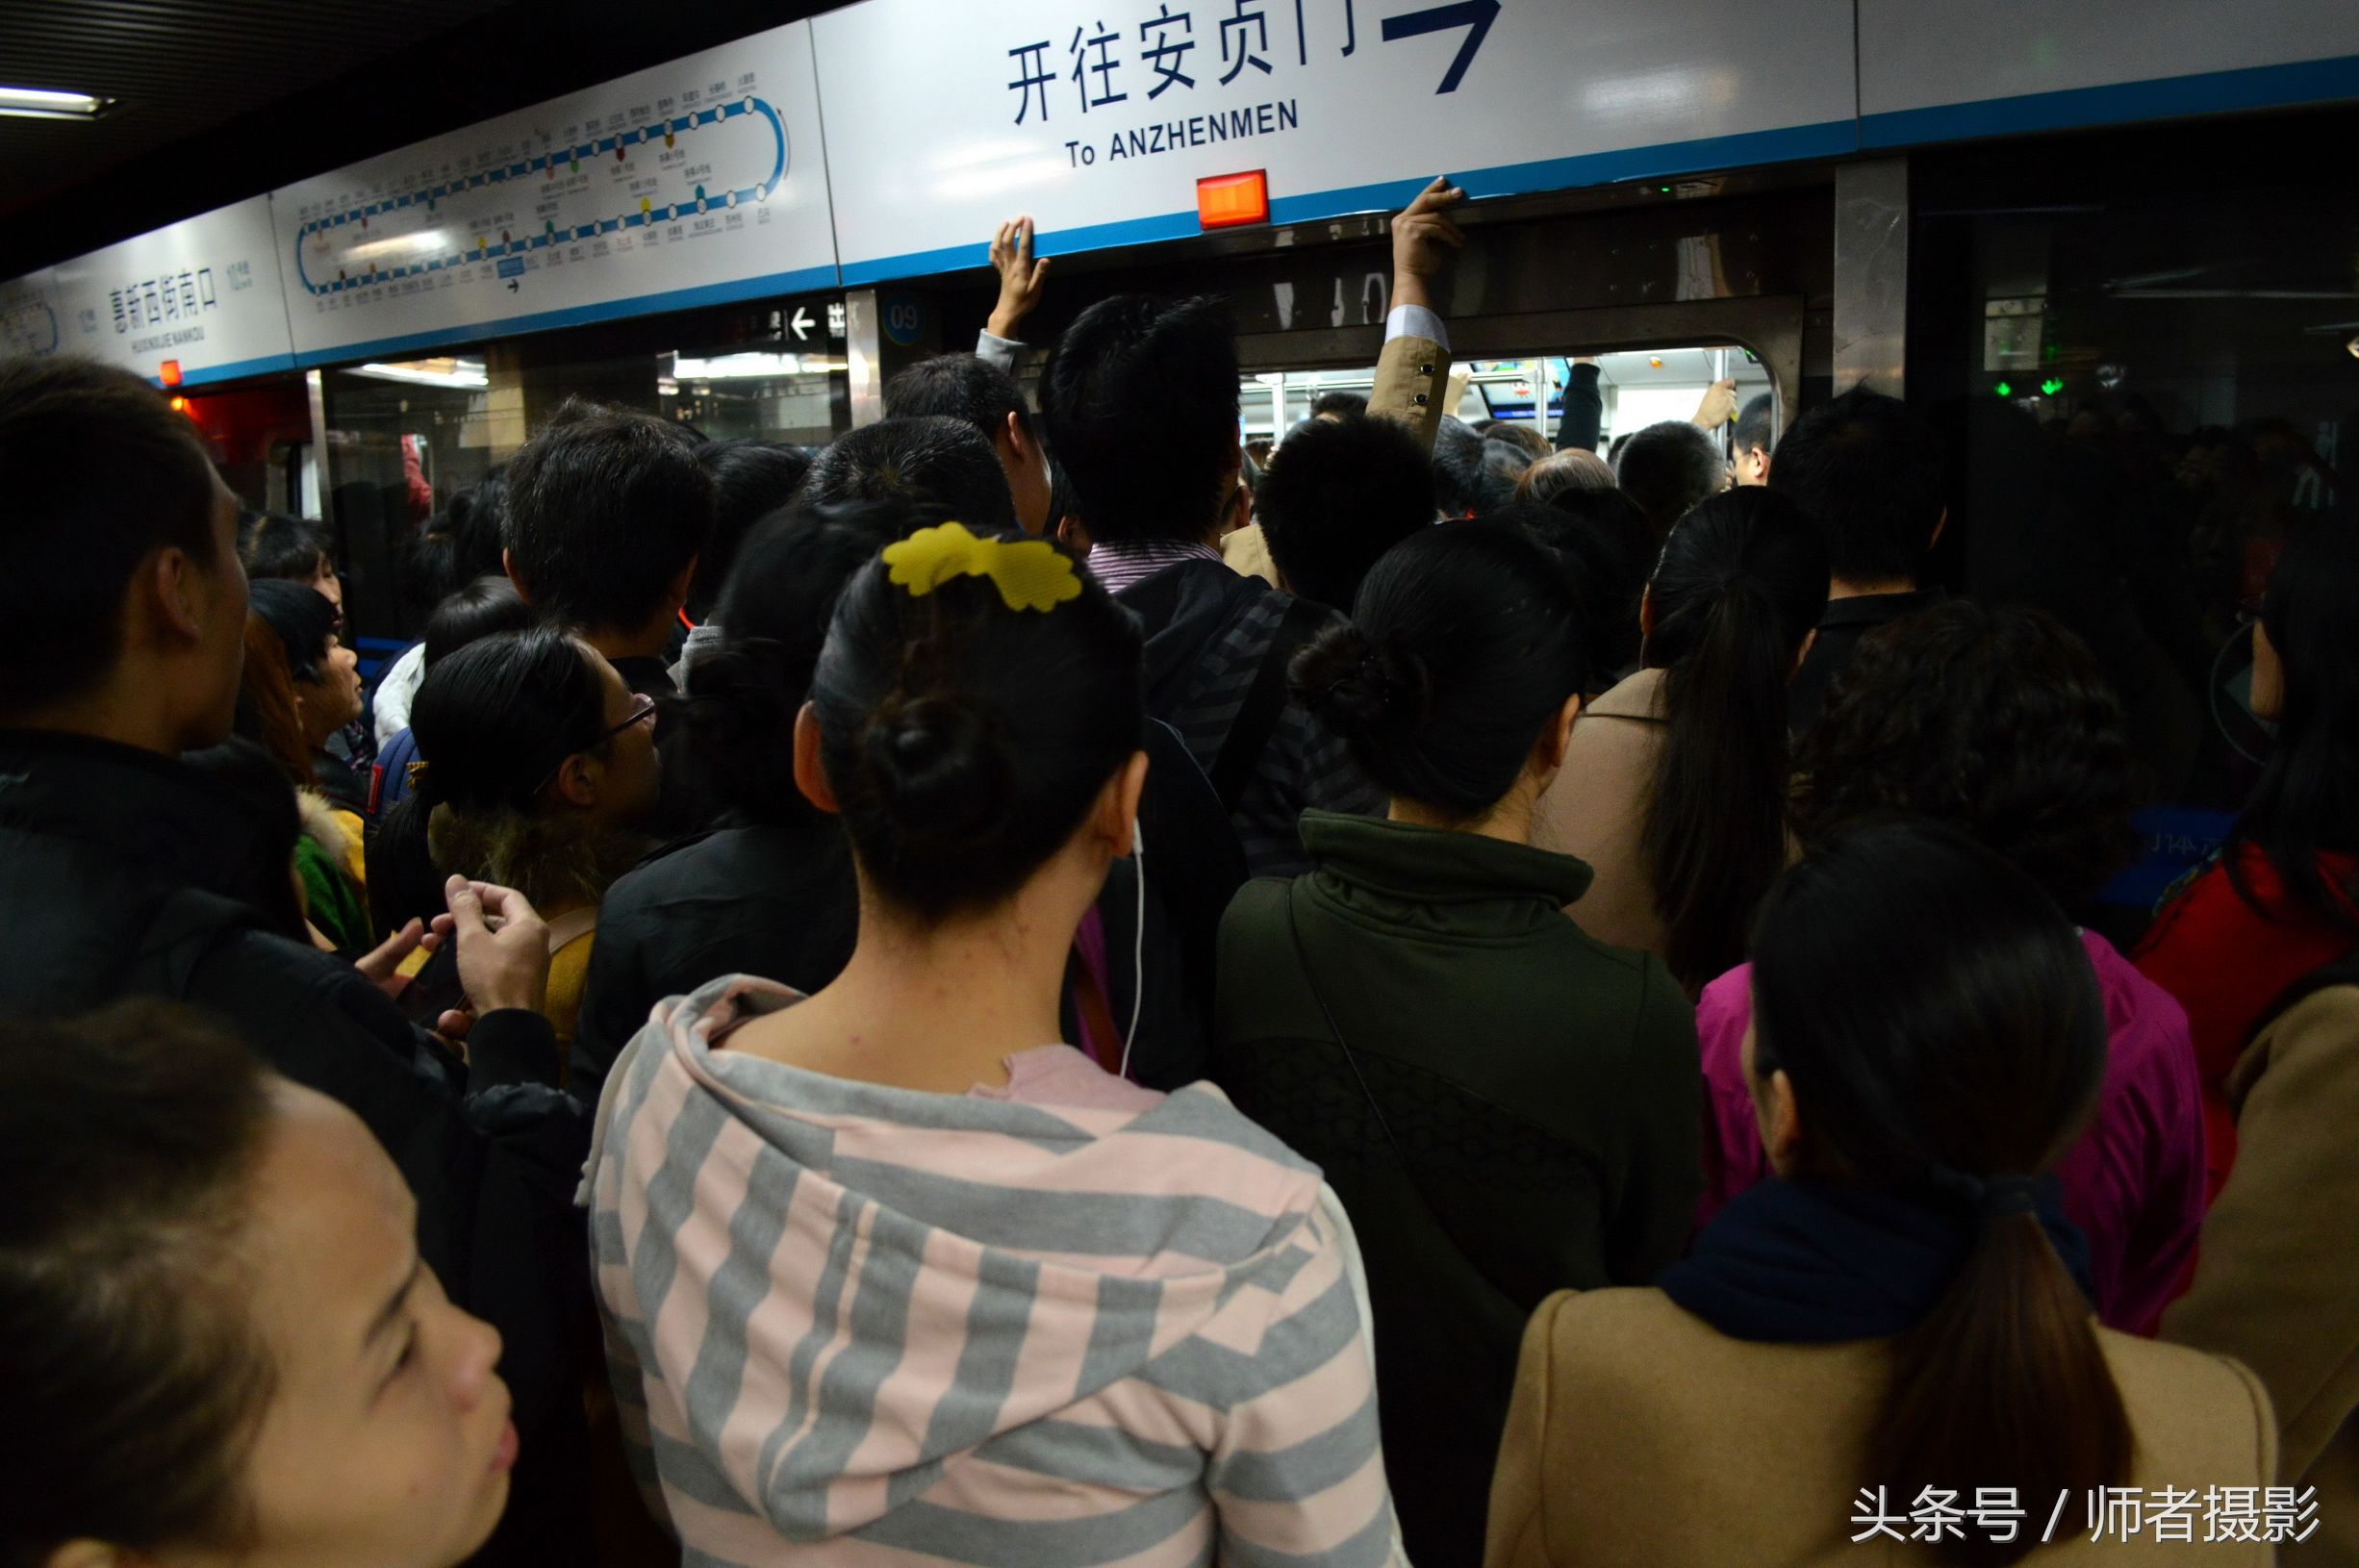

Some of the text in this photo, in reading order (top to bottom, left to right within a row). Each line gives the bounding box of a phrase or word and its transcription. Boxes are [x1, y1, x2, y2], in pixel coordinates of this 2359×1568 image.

[1066, 99, 1299, 168] To ANZHENMEN
[109, 267, 217, 334] 惠新西街南口
[890, 304, 918, 330] 09
